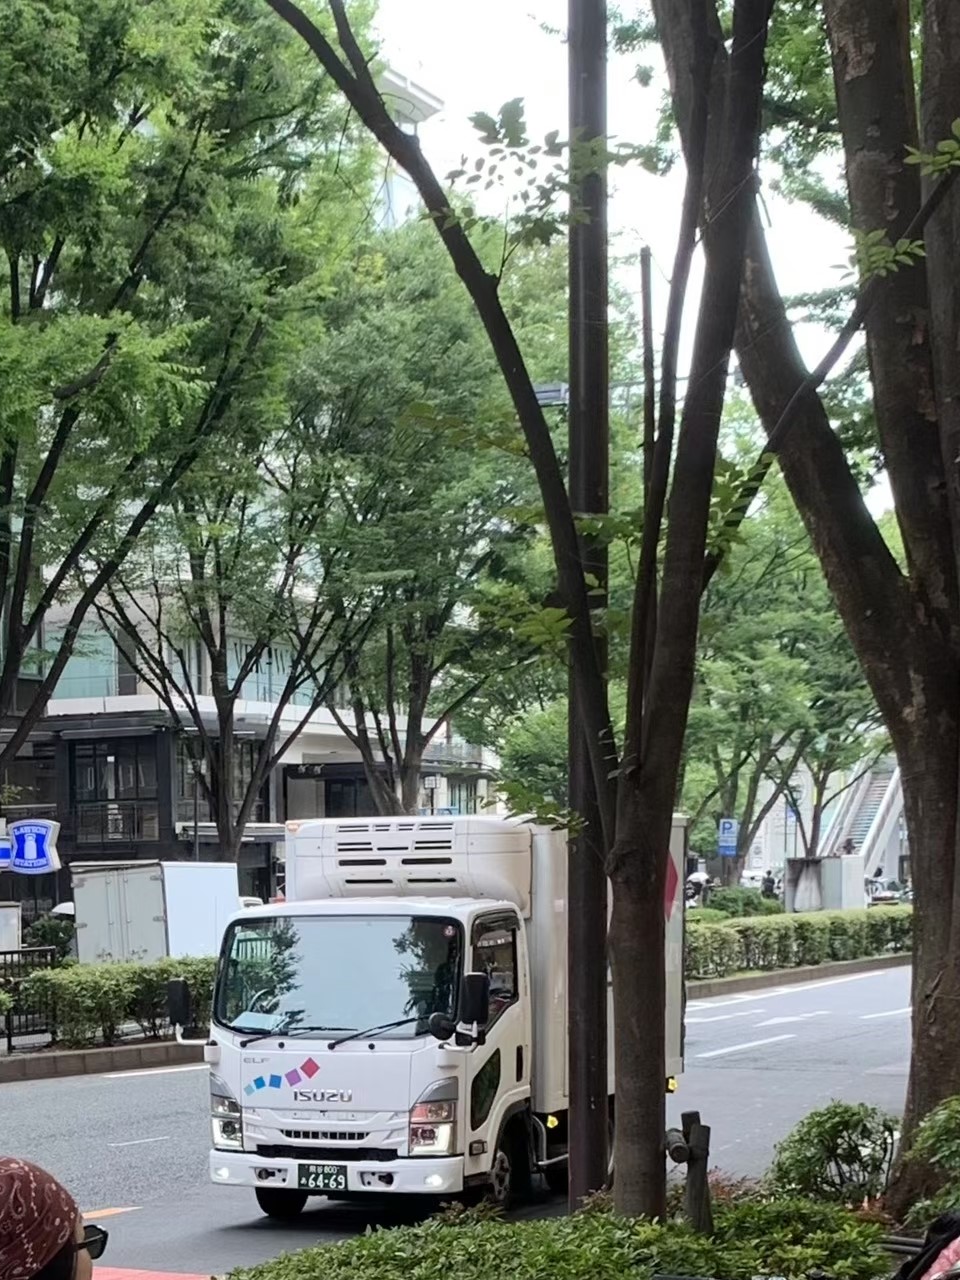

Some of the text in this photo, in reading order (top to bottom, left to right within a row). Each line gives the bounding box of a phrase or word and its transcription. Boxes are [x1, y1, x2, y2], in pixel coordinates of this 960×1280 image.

[722, 821, 733, 835] P
[293, 1089, 353, 1103] ISUZU
[308, 1174, 346, 1189] 64-69
